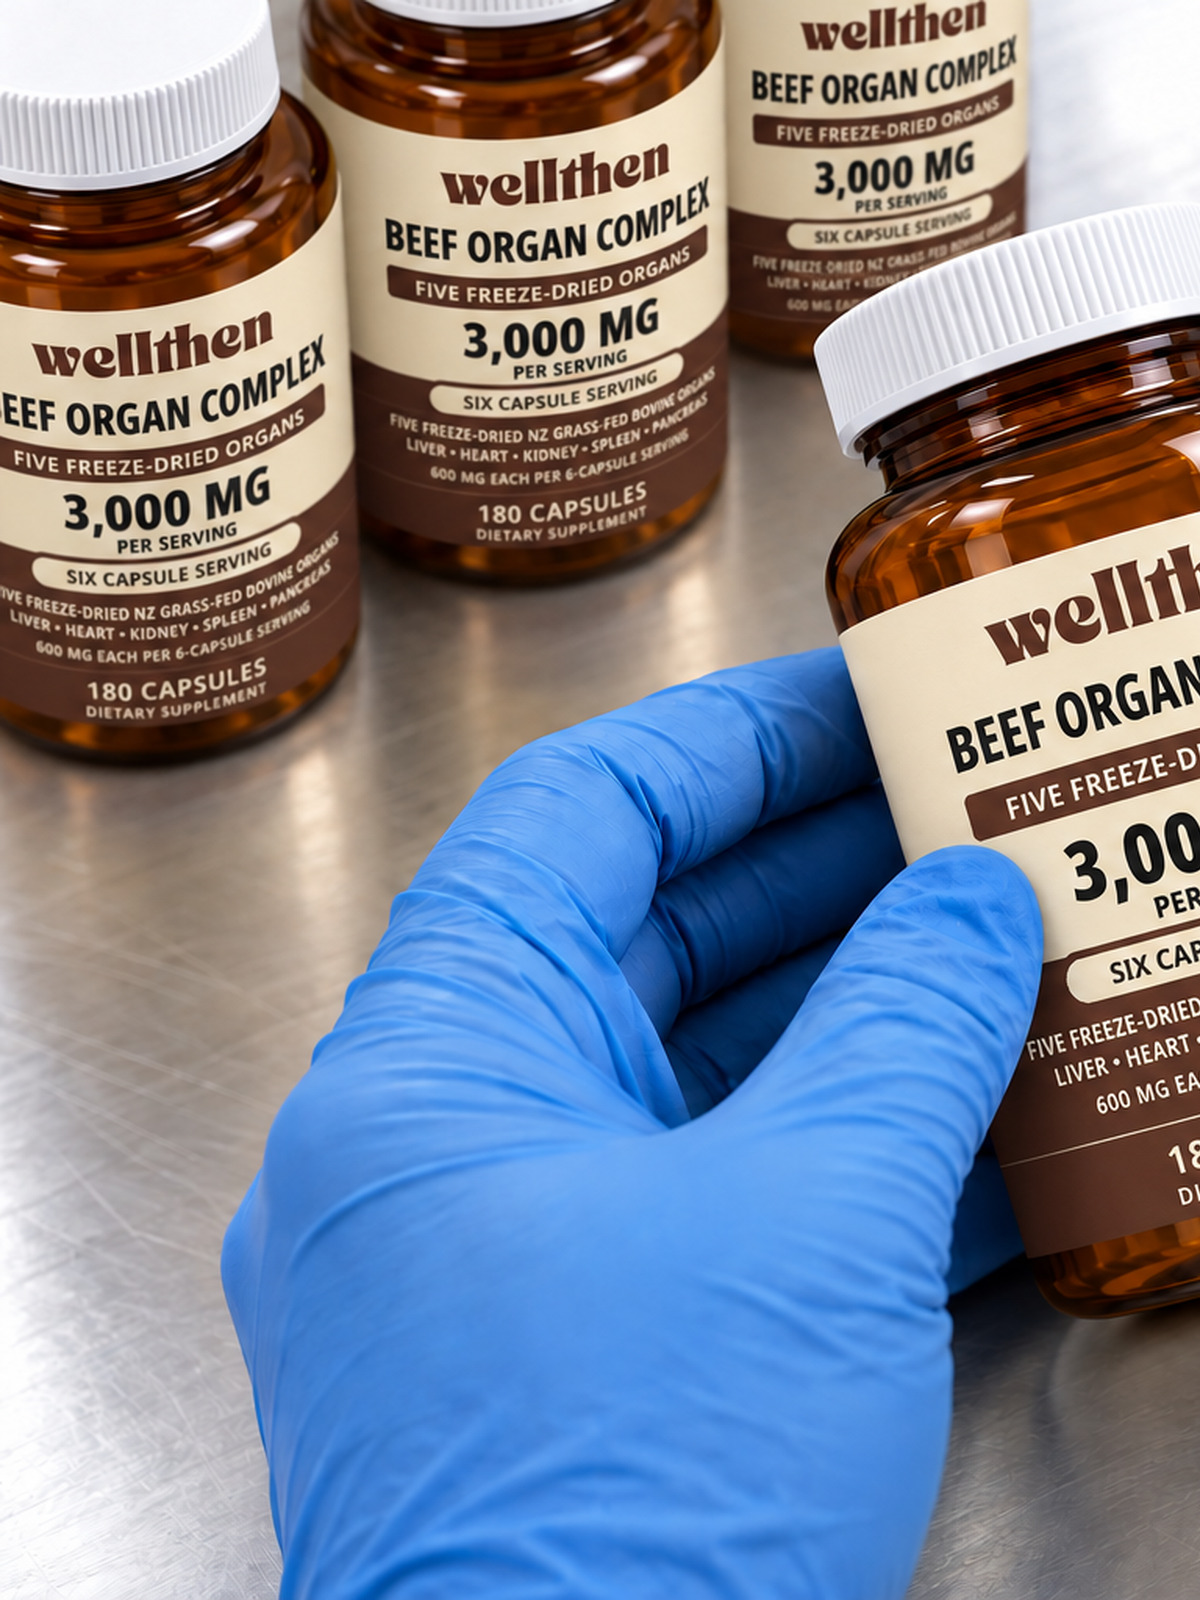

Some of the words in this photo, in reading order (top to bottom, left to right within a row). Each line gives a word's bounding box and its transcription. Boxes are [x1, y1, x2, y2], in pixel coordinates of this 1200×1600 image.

[801, 0, 985, 50] wellthen
[752, 70, 813, 103] BEEF
[822, 68, 917, 104] ORGAN
[926, 36, 1016, 93] COMPLEX
[777, 125, 813, 142] FIVE
[820, 117, 937, 141] FREEZE-DRIED
[942, 96, 998, 127] ORGANS
[441, 144, 669, 206] wellthen
[815, 156, 913, 200] 3,000
[925, 141, 973, 184] MG
[386, 219, 456, 260] BEEF
[468, 224, 586, 263] ORGAN
[597, 177, 709, 251] COMPLEX
[855, 199, 882, 213] PER
[815, 231, 839, 244] SIX
[844, 224, 909, 242] CAPSULE
[416, 281, 459, 301] FIVE
[467, 276, 613, 303] FREEZE-DRIED
[620, 246, 689, 286] ORGANS
[32, 312, 272, 378] wellthen
[464, 318, 584, 365] 3,000
[600, 298, 658, 347] MG
[514, 365, 546, 379] PER
[554, 349, 627, 376] SERVING
[3, 393, 55, 431] EEF
[67, 396, 190, 435] ORGAN
[201, 335, 325, 422] COMPLEX
[464, 396, 492, 410] SIX
[499, 391, 580, 410] CAPSULE
[587, 370, 657, 401] SERVING
[14, 450, 58, 472] FIVE
[67, 447, 218, 475] FREEZE-DRIED
[226, 409, 304, 457] ORGANS
[390, 413, 418, 432] FIVE
[423, 422, 523, 443] FREEZE-DRIED
[528, 428, 548, 442] NZ
[553, 413, 628, 439] GRASS-FED
[407, 438, 446, 458] LIVER
[461, 448, 508, 462] HEART
[524, 445, 578, 462] KIDNEY
[592, 428, 640, 453] SPLEEN
[431, 466, 456, 481] 600
[461, 471, 485, 485] MG
[491, 473, 529, 485] EACH
[535, 470, 561, 483] PER
[565, 452, 637, 480] 6-CAPSULE
[64, 490, 190, 538] 3,000
[206, 466, 269, 520] MG
[477, 528, 542, 541] DIETARY
[547, 502, 646, 539] SUPPLEMENT
[479, 505, 521, 523] 180
[530, 481, 646, 522] CAPSULES
[118, 539, 152, 554] PER
[159, 522, 236, 551] SERVING
[67, 570, 96, 586] SIX
[103, 567, 188, 586] CAPSULE
[196, 542, 271, 578] SERVING
[11, 609, 50, 632] LIVER
[66, 624, 114, 640] HEART
[131, 623, 188, 640] KIDNEY
[203, 604, 257, 632] SPLEEN
[26, 595, 129, 621] FREEZE-DRIED
[134, 606, 155, 620] NZ
[160, 590, 242, 618] GRASS-FED
[36, 641, 63, 657] 600
[68, 647, 92, 661] MG
[98, 650, 137, 663] EACH
[143, 649, 170, 662] PER
[176, 625, 253, 659] 6-CAPSULE
[86, 706, 155, 719] DIETARY
[159, 679, 266, 717] SUPPLEMENT
[88, 682, 132, 701] 180
[142, 657, 266, 702] CAPSULES
[946, 701, 1045, 773] BEEF
[1006, 784, 1064, 820] FIVE
[1110, 955, 1152, 983] SIX
[1027, 1033, 1066, 1060] FIVE
[1055, 1057, 1109, 1086] LIVER
[1125, 1034, 1189, 1067] HEART
[1097, 1090, 1130, 1114] 600
[1136, 1080, 1170, 1104] MG
